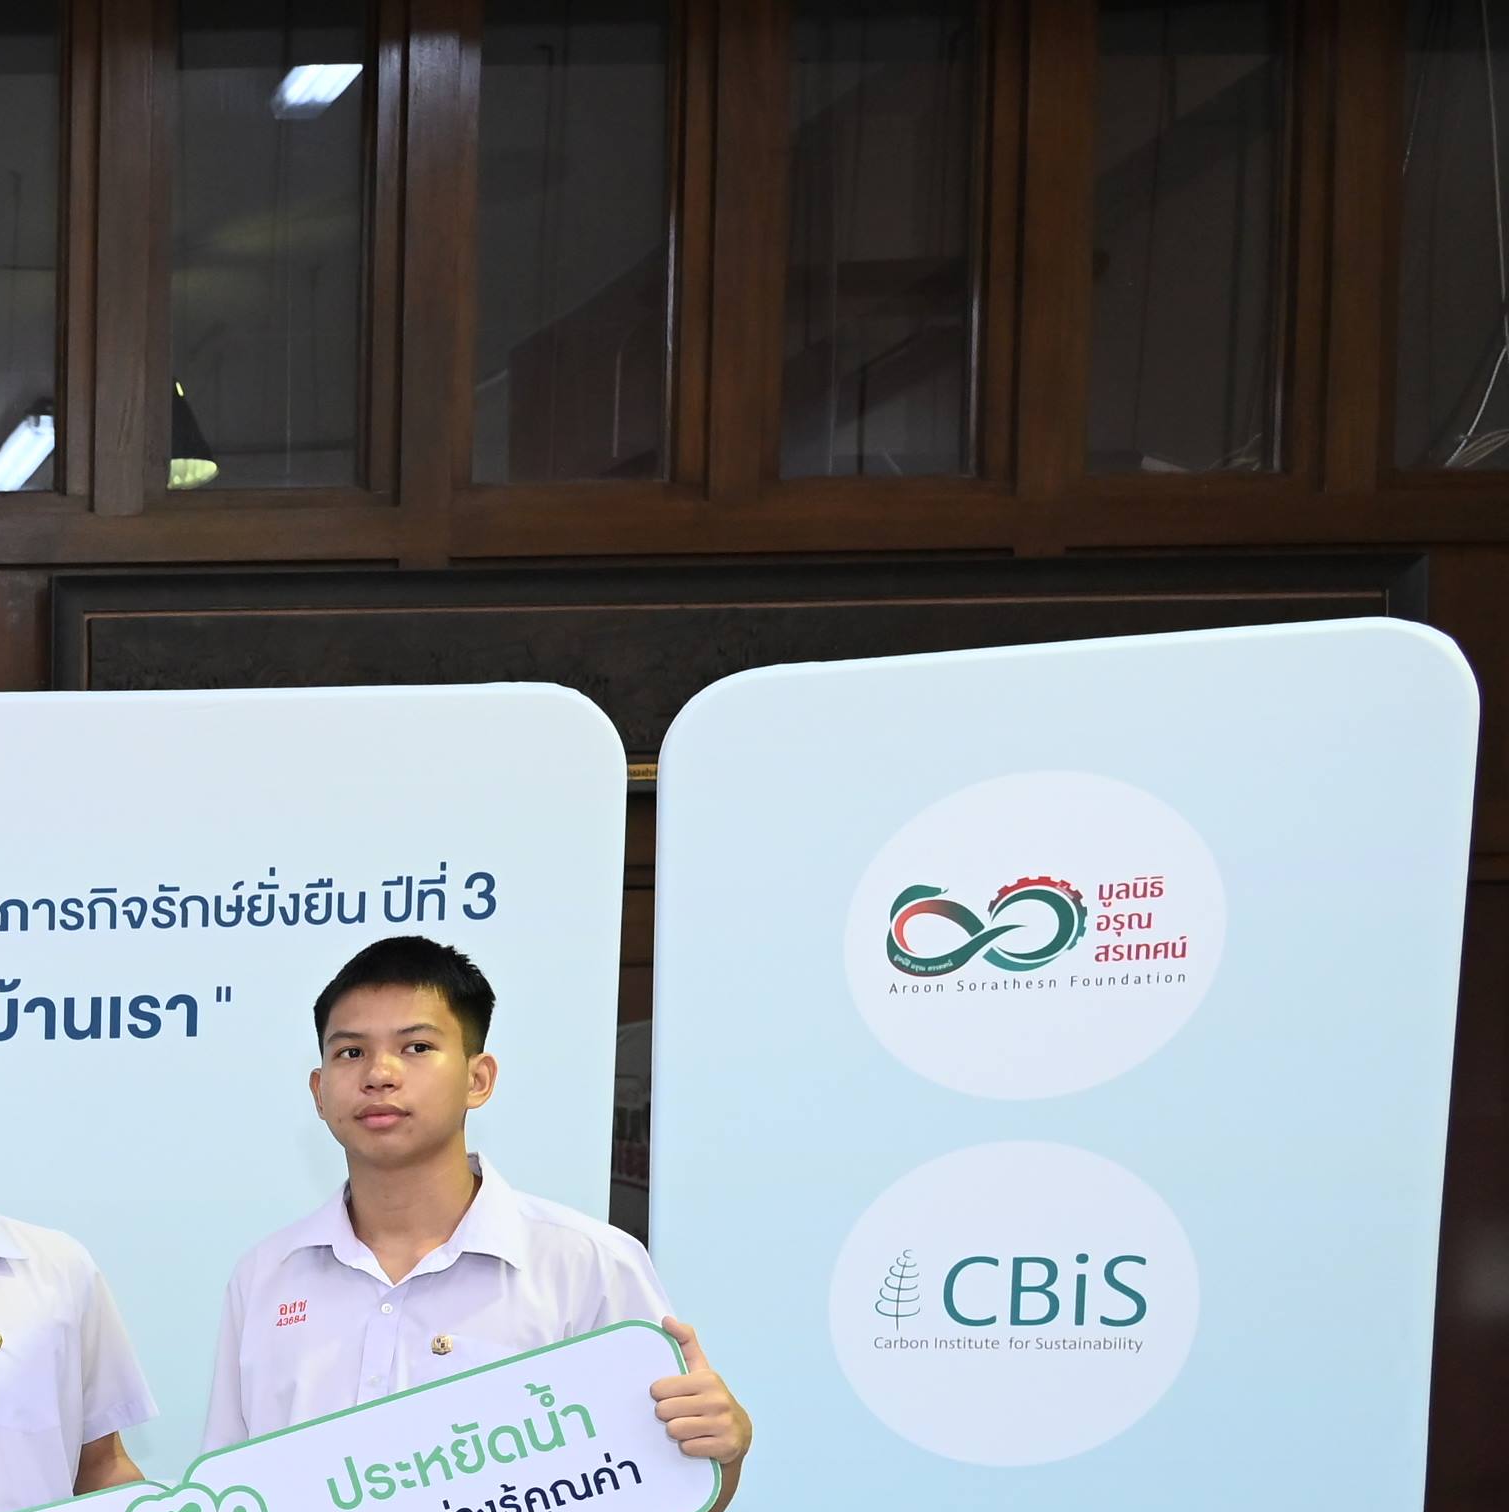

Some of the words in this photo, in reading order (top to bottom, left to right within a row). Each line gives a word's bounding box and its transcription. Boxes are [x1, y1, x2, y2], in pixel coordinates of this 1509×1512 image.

[381, 862, 448, 923] ปีที่
[462, 872, 498, 920] 3
[1097, 875, 1165, 908] มูลนิธิ
[1096, 911, 1153, 937] อรุณ
[1094, 935, 1189, 963] สรเทศน์
[889, 981, 945, 995] Aroon
[957, 977, 1058, 992] Sorathesn
[1070, 971, 1187, 988] Foundation
[943, 1253, 1148, 1327] CBiS
[874, 1336, 929, 1350] Carbon
[934, 1336, 1001, 1350] Institute
[1008, 1336, 1031, 1350] for
[1035, 1336, 1144, 1353] Sustainability
[327, 1383, 597, 1511] ประหยัดน้ำ
